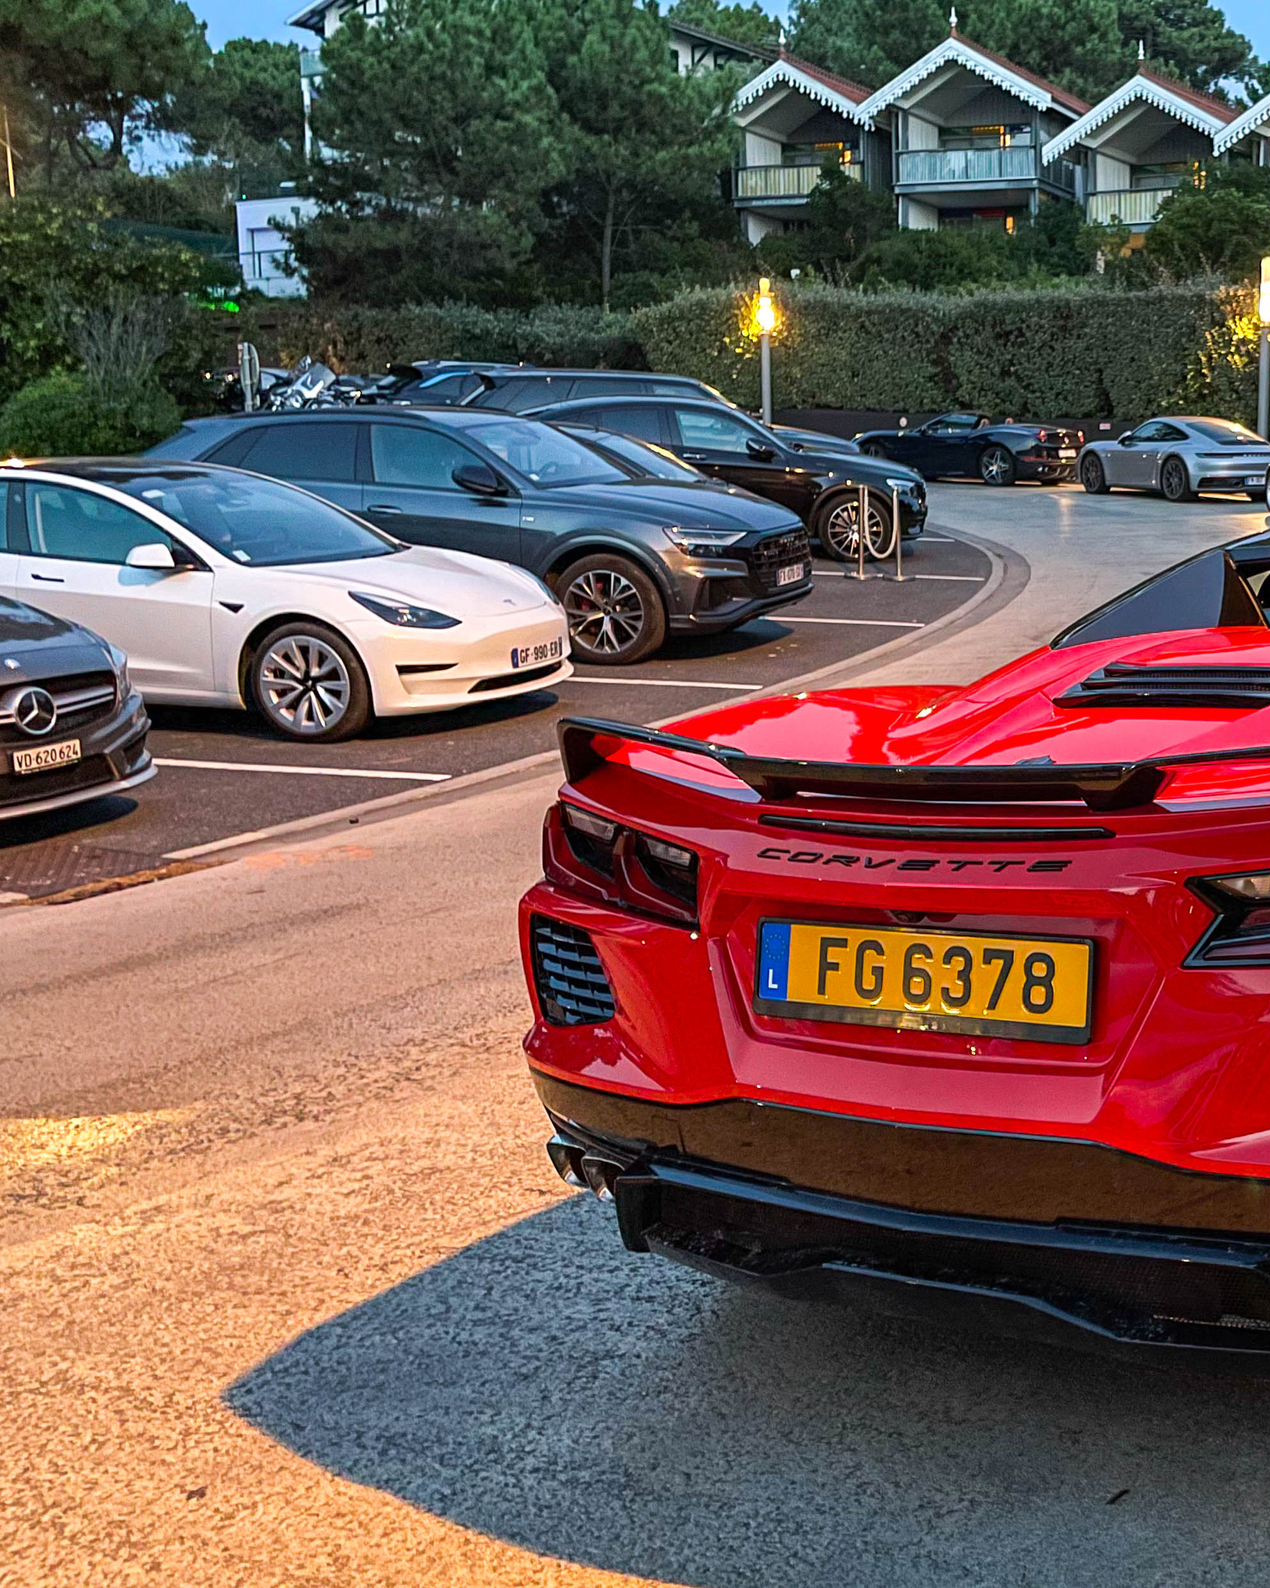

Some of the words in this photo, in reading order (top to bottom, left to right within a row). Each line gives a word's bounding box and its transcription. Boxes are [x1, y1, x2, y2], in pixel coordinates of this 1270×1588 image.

[757, 847, 1073, 872] CORVETTE
[768, 968, 778, 989] L
[817, 936, 885, 1000] FG
[902, 943, 1056, 1014] 6378
